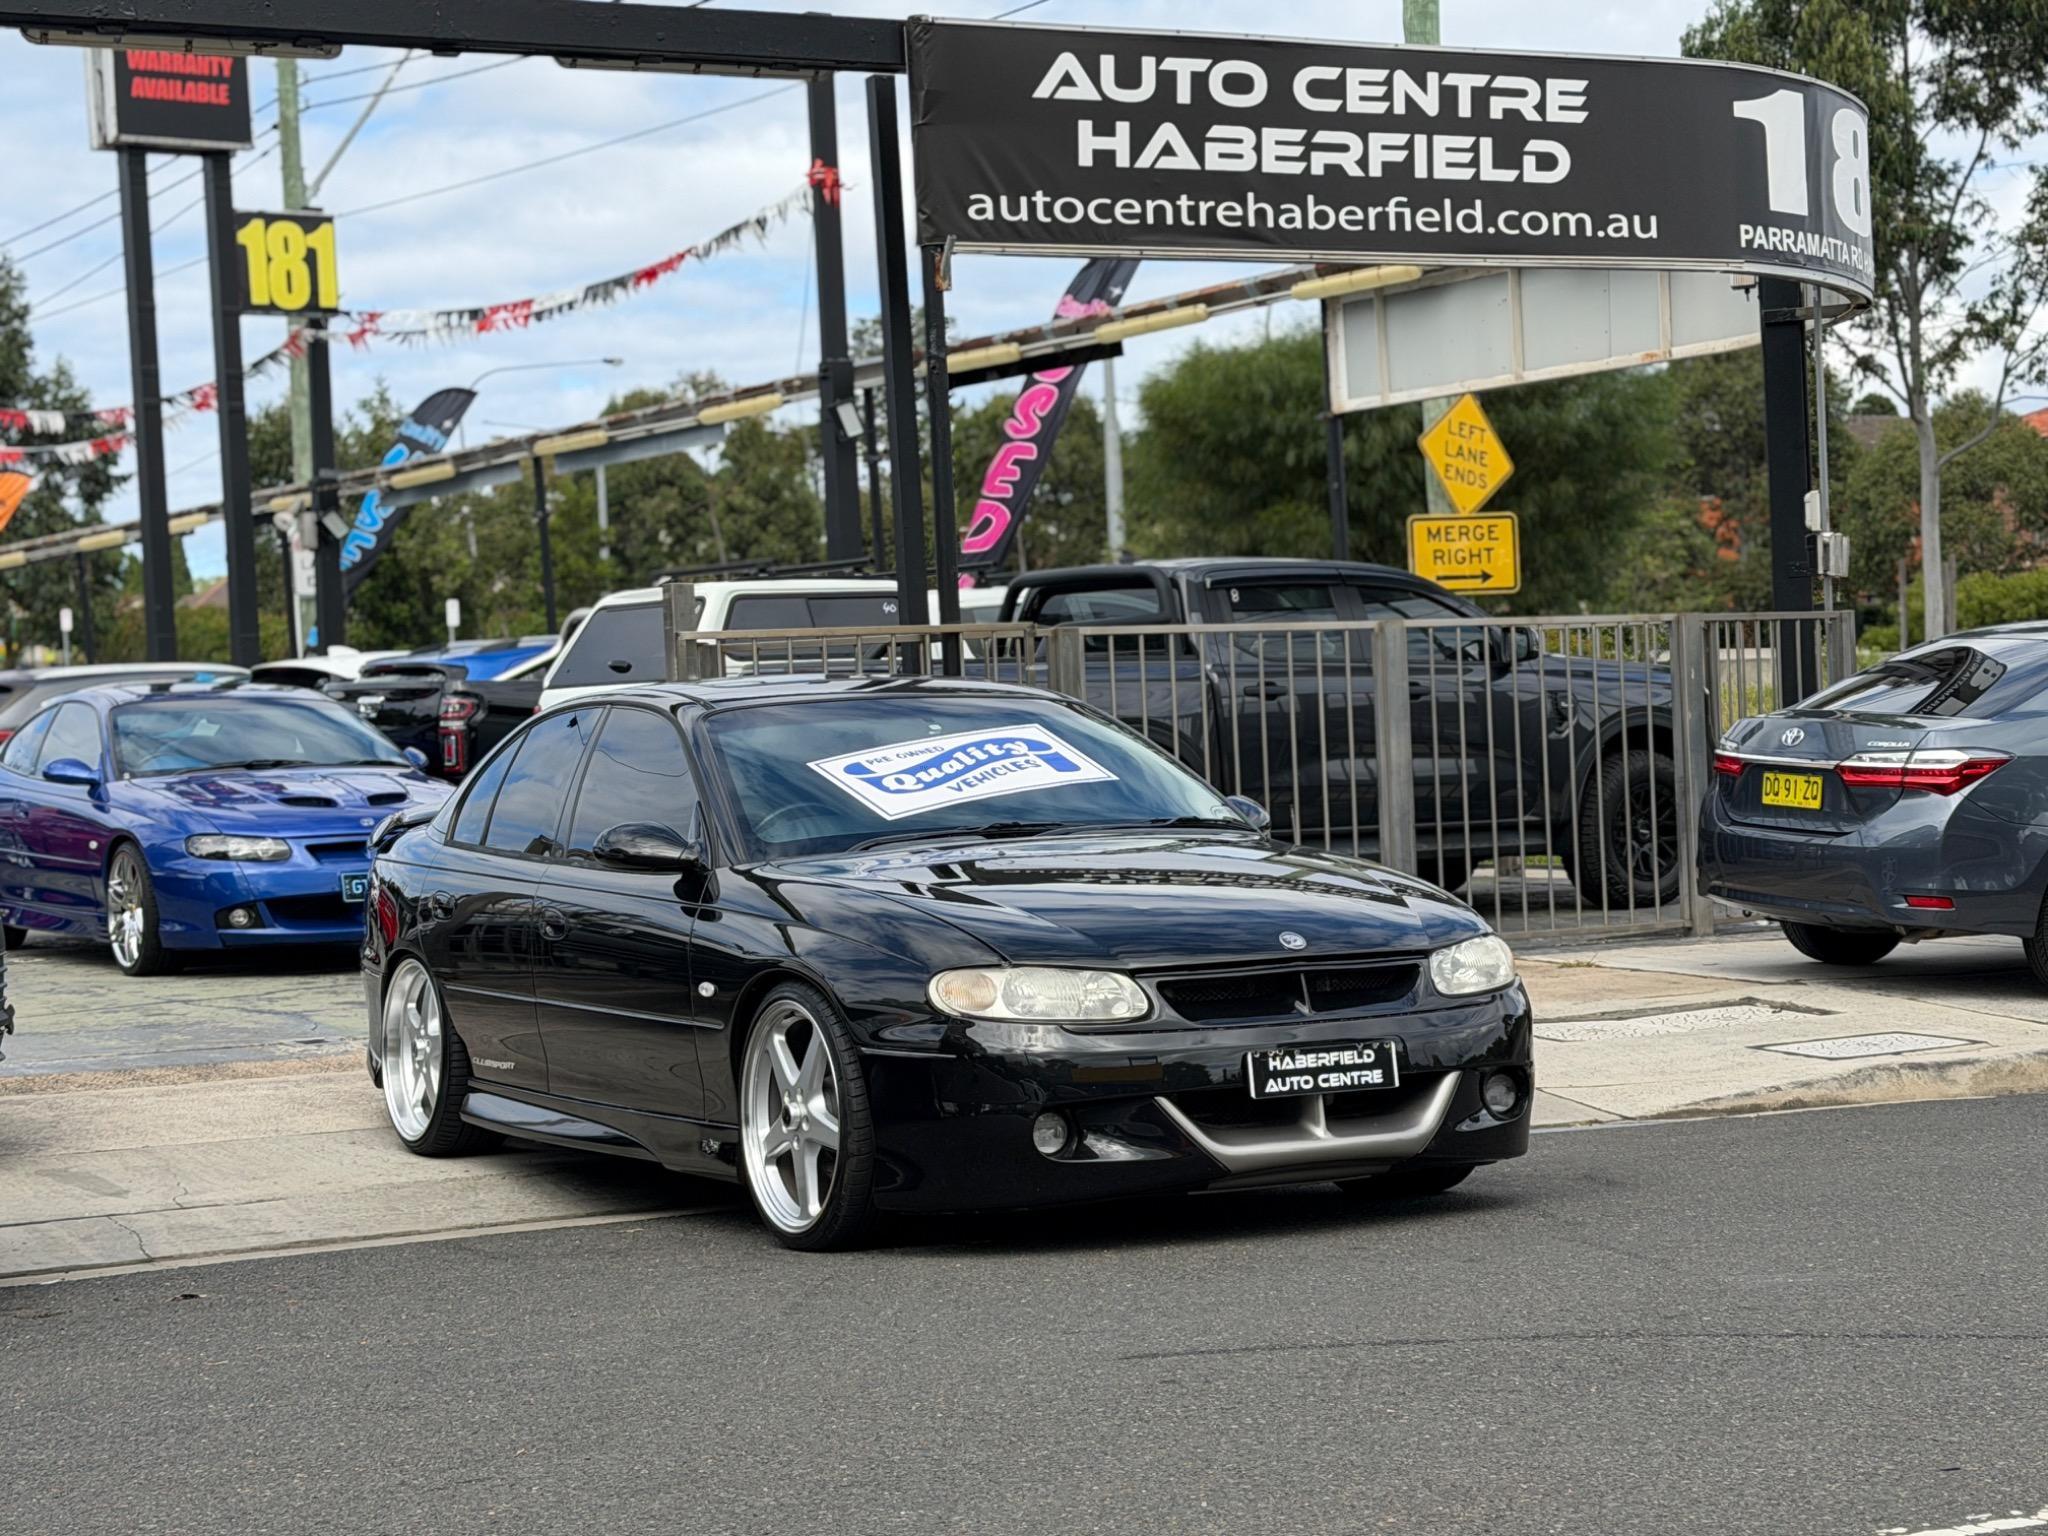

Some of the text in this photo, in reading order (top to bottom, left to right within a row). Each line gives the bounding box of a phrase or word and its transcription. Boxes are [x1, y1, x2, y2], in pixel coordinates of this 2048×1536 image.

[126, 49, 233, 78] WARRANTY
[131, 76, 231, 106] AVAILABLE
[1031, 51, 1590, 123] AUTO CENTRE
[1078, 119, 1571, 184] HABERFIELD
[967, 190, 1658, 239] autocentrehaberfield.com.au
[1739, 223, 1850, 266] PARRAMATTA
[235, 217, 338, 311] 181
[1447, 418, 1487, 445] LEFT
[961, 365, 1074, 553] SED
[1445, 440, 1489, 468] LANE
[1443, 463, 1488, 490] ENDS
[1426, 524, 1500, 544] MERGE
[1432, 547, 1496, 566] RIGHT
[882, 601, 897, 615] 40
[865, 745, 945, 766] PRE OWNED
[881, 737, 1031, 791] Quality
[945, 757, 1043, 793] VEHICLES
[1784, 778, 1799, 800] 91
[1268, 1048, 1376, 1072] HABERFIELD
[1264, 1068, 1384, 1093] AUTO CENTRE
